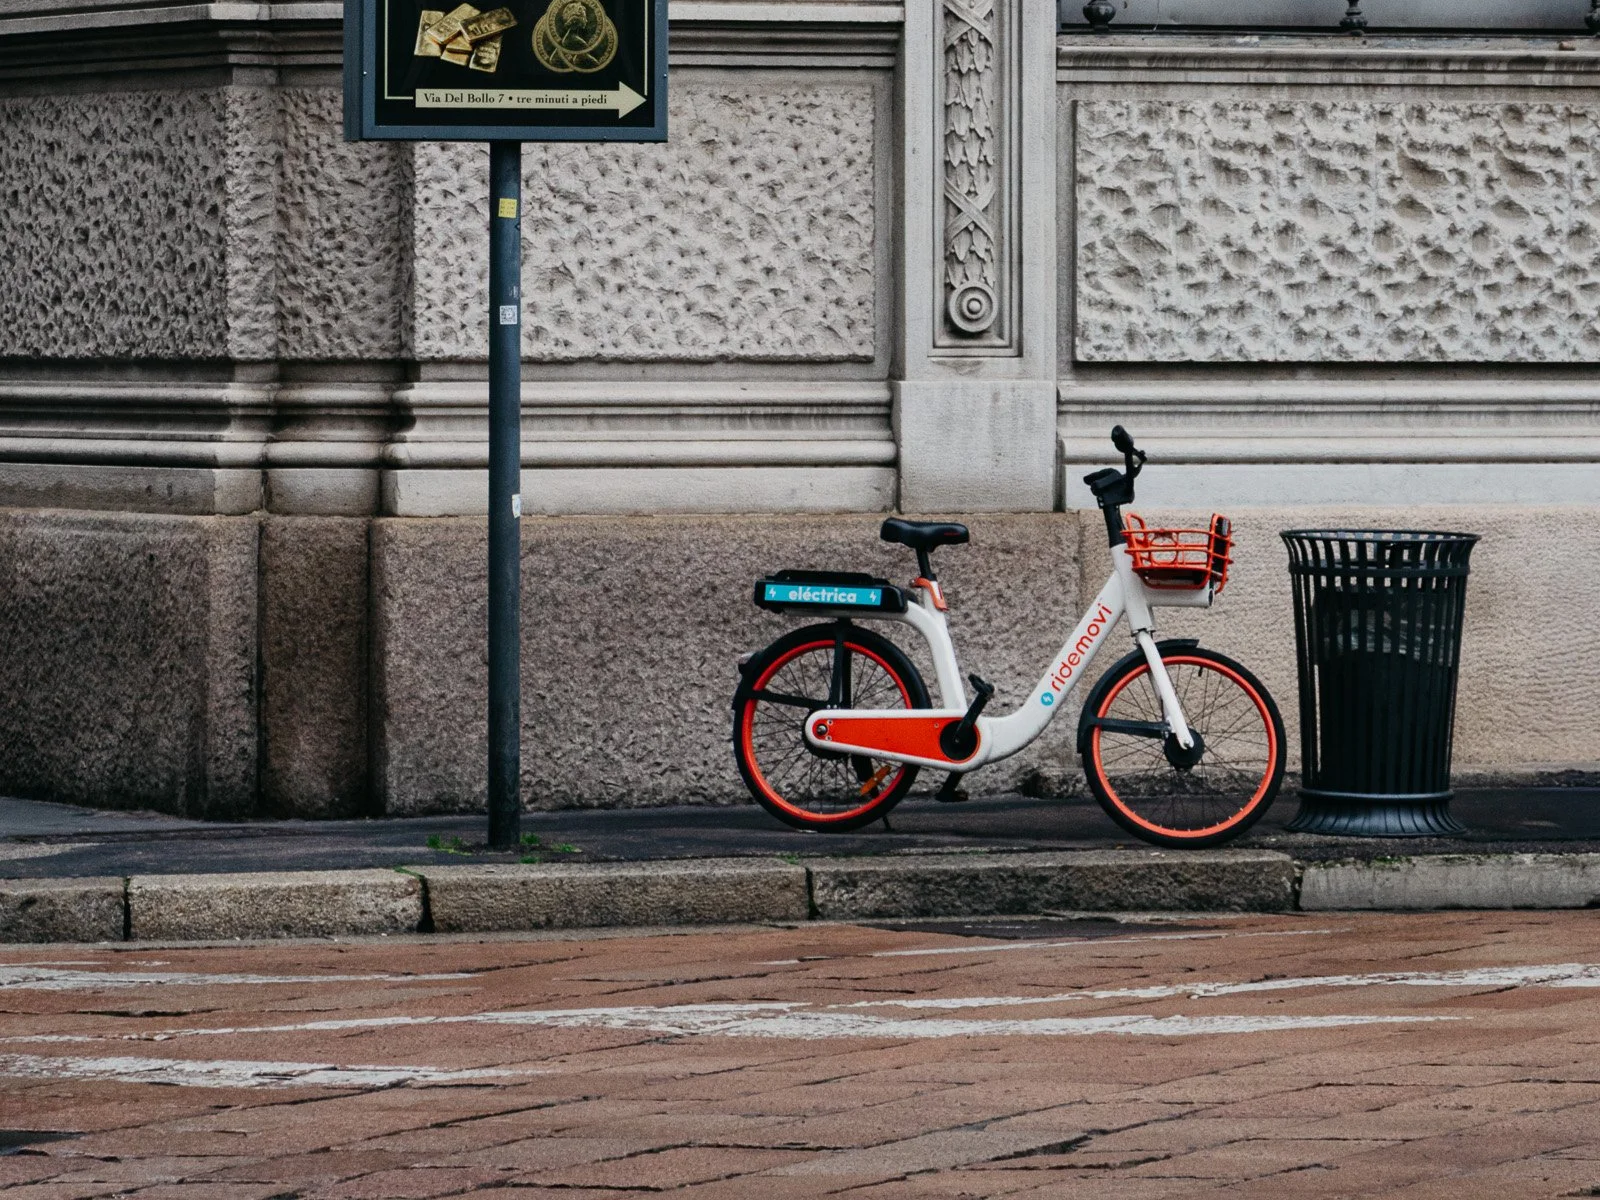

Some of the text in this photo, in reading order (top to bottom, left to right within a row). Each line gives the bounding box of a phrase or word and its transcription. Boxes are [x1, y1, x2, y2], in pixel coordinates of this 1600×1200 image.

[423, 92, 608, 108] Via Del Bollo 7 tre minuti a piedi
[788, 586, 857, 603] eléctrica
[1051, 602, 1112, 692] ridemovi
